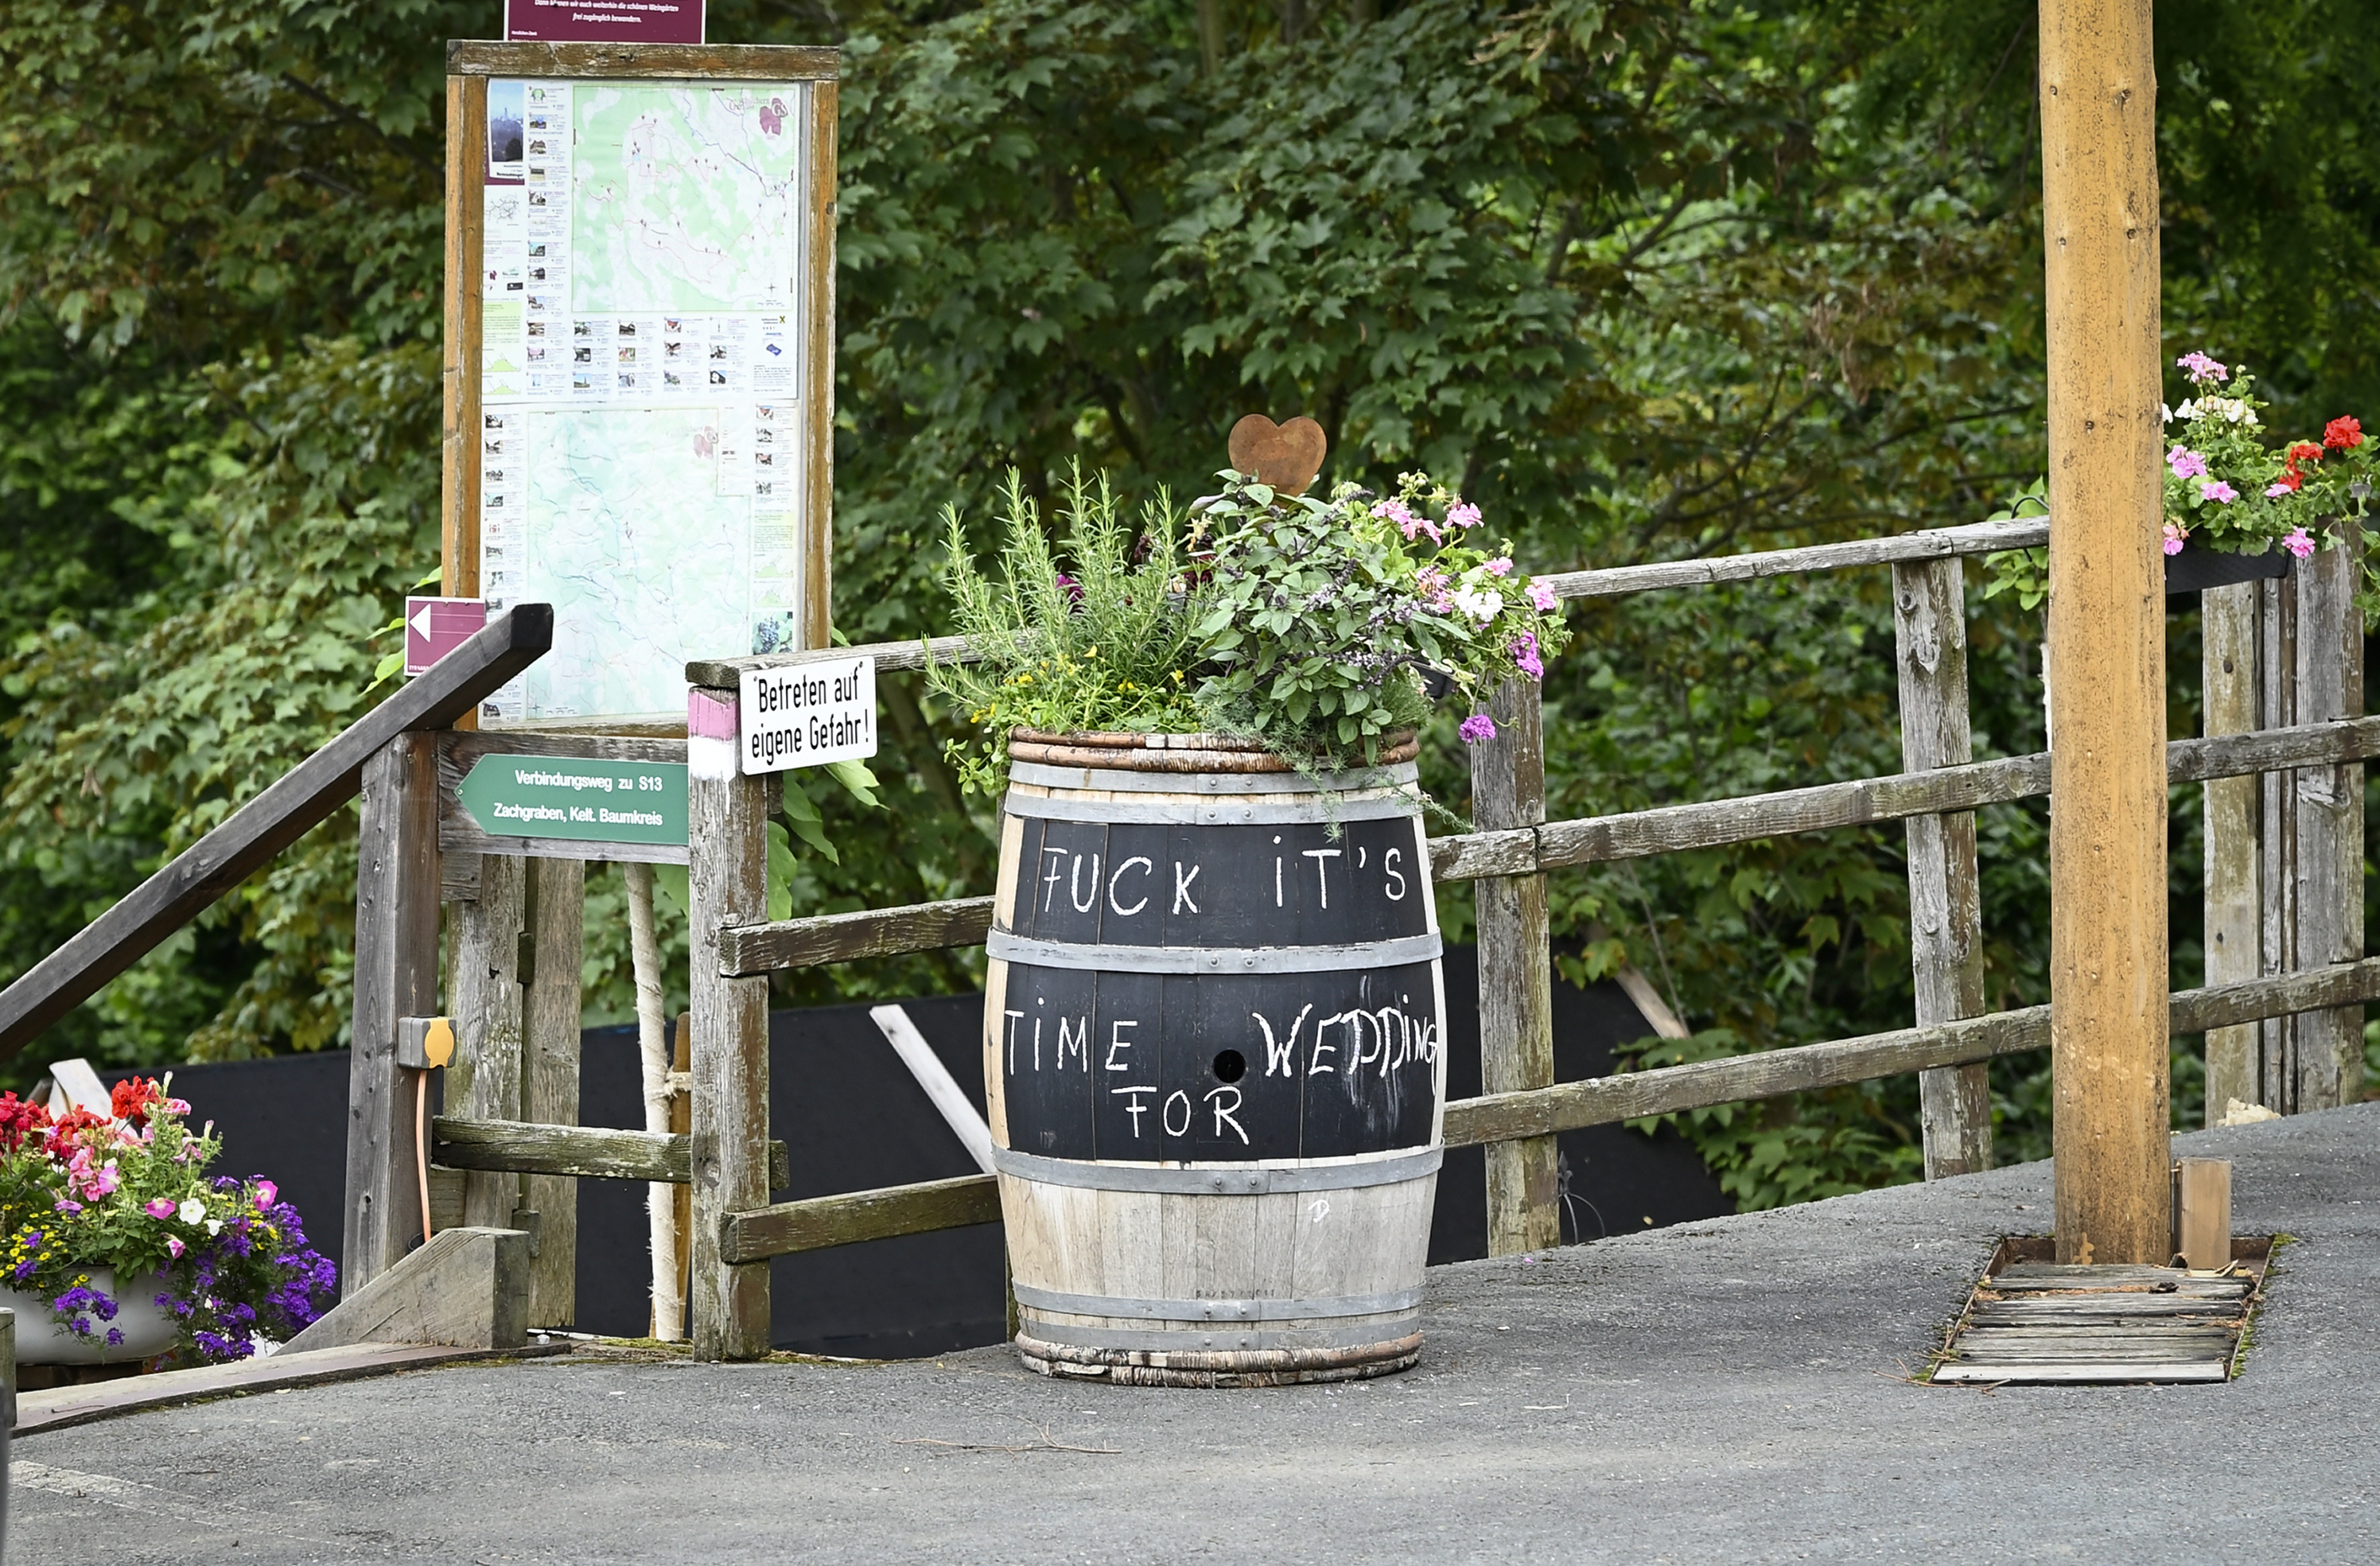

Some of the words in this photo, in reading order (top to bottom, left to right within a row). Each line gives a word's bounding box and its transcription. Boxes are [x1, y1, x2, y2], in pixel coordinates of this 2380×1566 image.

[758, 674, 826, 713] Betreten
[834, 666, 859, 702] auf
[752, 723, 803, 766] eigene
[515, 769, 612, 792] Verbindungsweg
[618, 777, 633, 790] zu
[639, 776, 663, 792] S13
[493, 802, 567, 823] Zachgraben,
[570, 806, 596, 822] Kelt.
[600, 808, 663, 826] Baumkreis
[1042, 847, 1200, 916] FUCK
[1111, 1086, 1250, 1145] FOR
